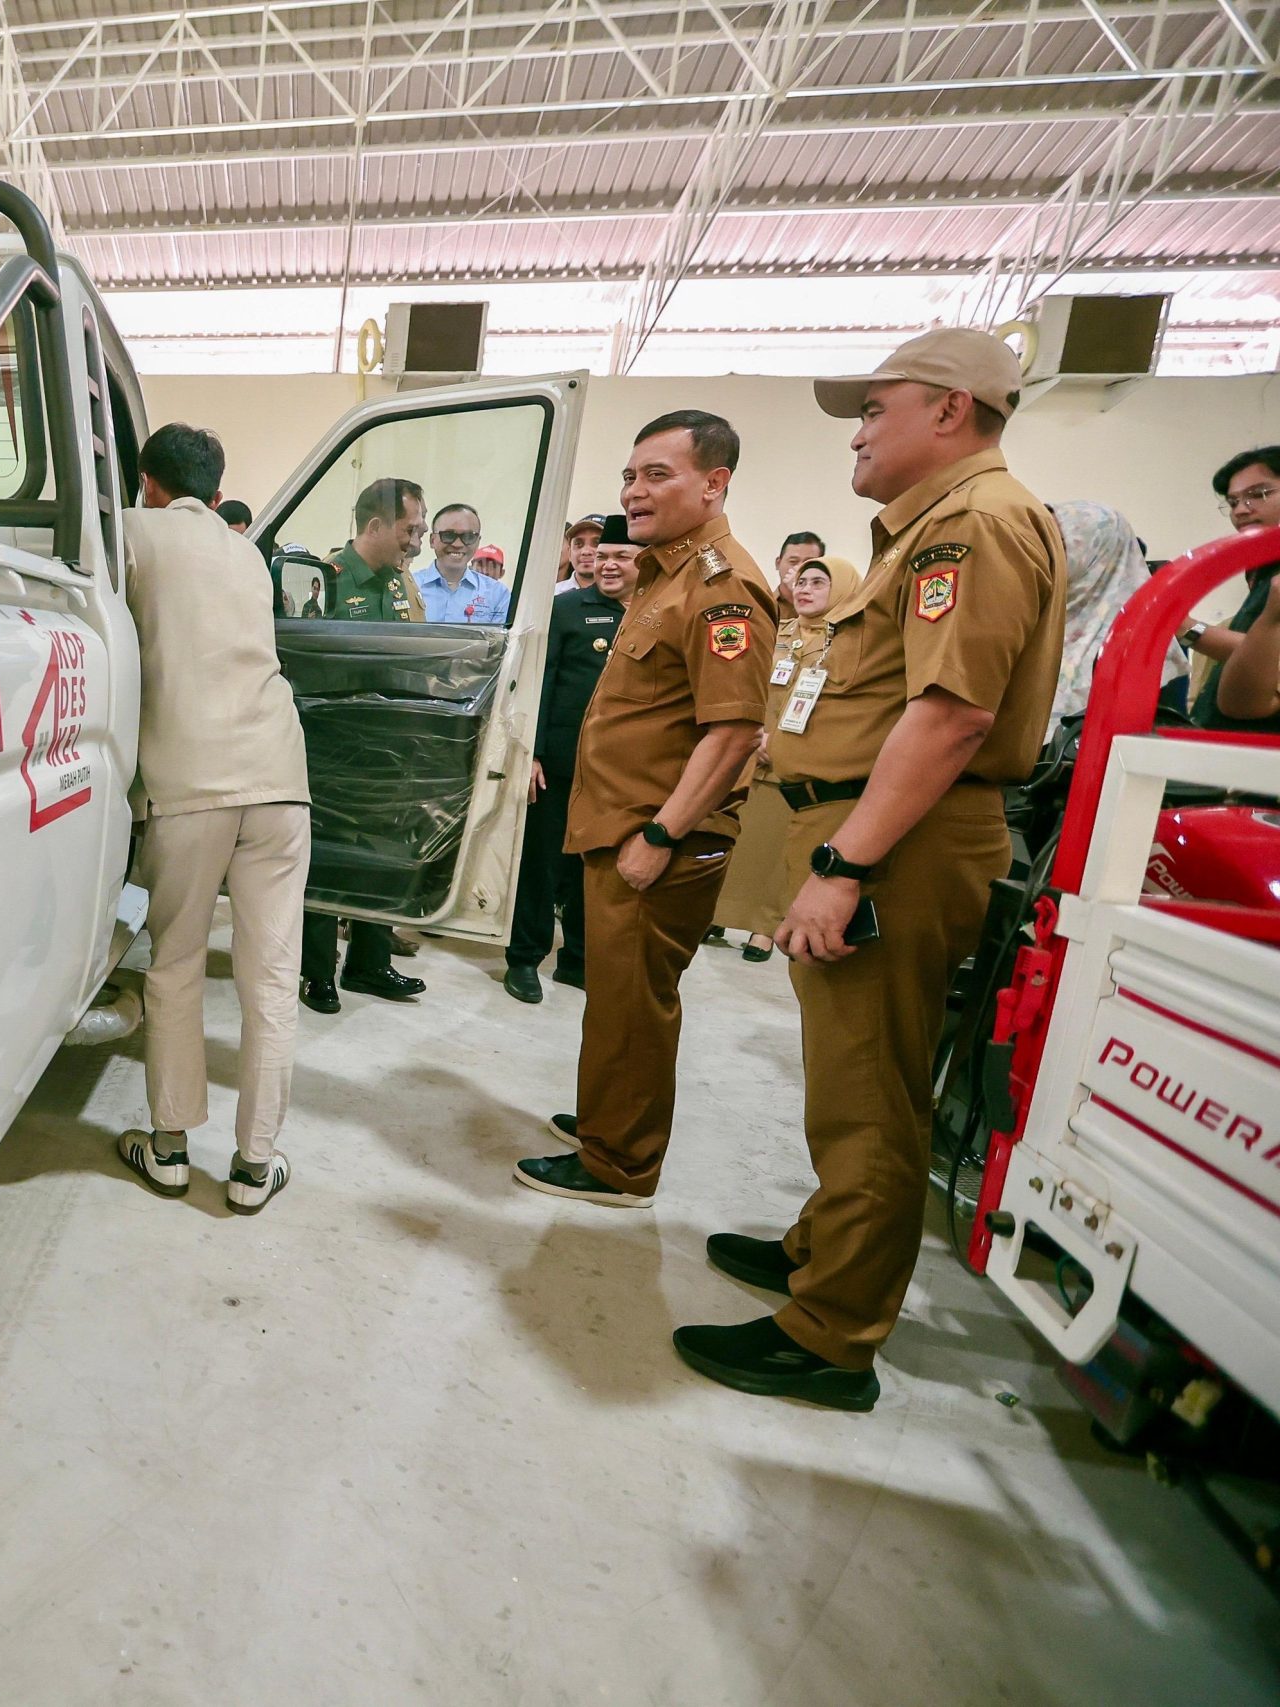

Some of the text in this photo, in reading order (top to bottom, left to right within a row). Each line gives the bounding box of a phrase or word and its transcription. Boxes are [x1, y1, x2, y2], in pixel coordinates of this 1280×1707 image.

[50, 630, 85, 669] KOP
[60, 676, 85, 719] DES
[51, 724, 81, 767] KEL
[59, 765, 91, 792] MERAH PUTIH
